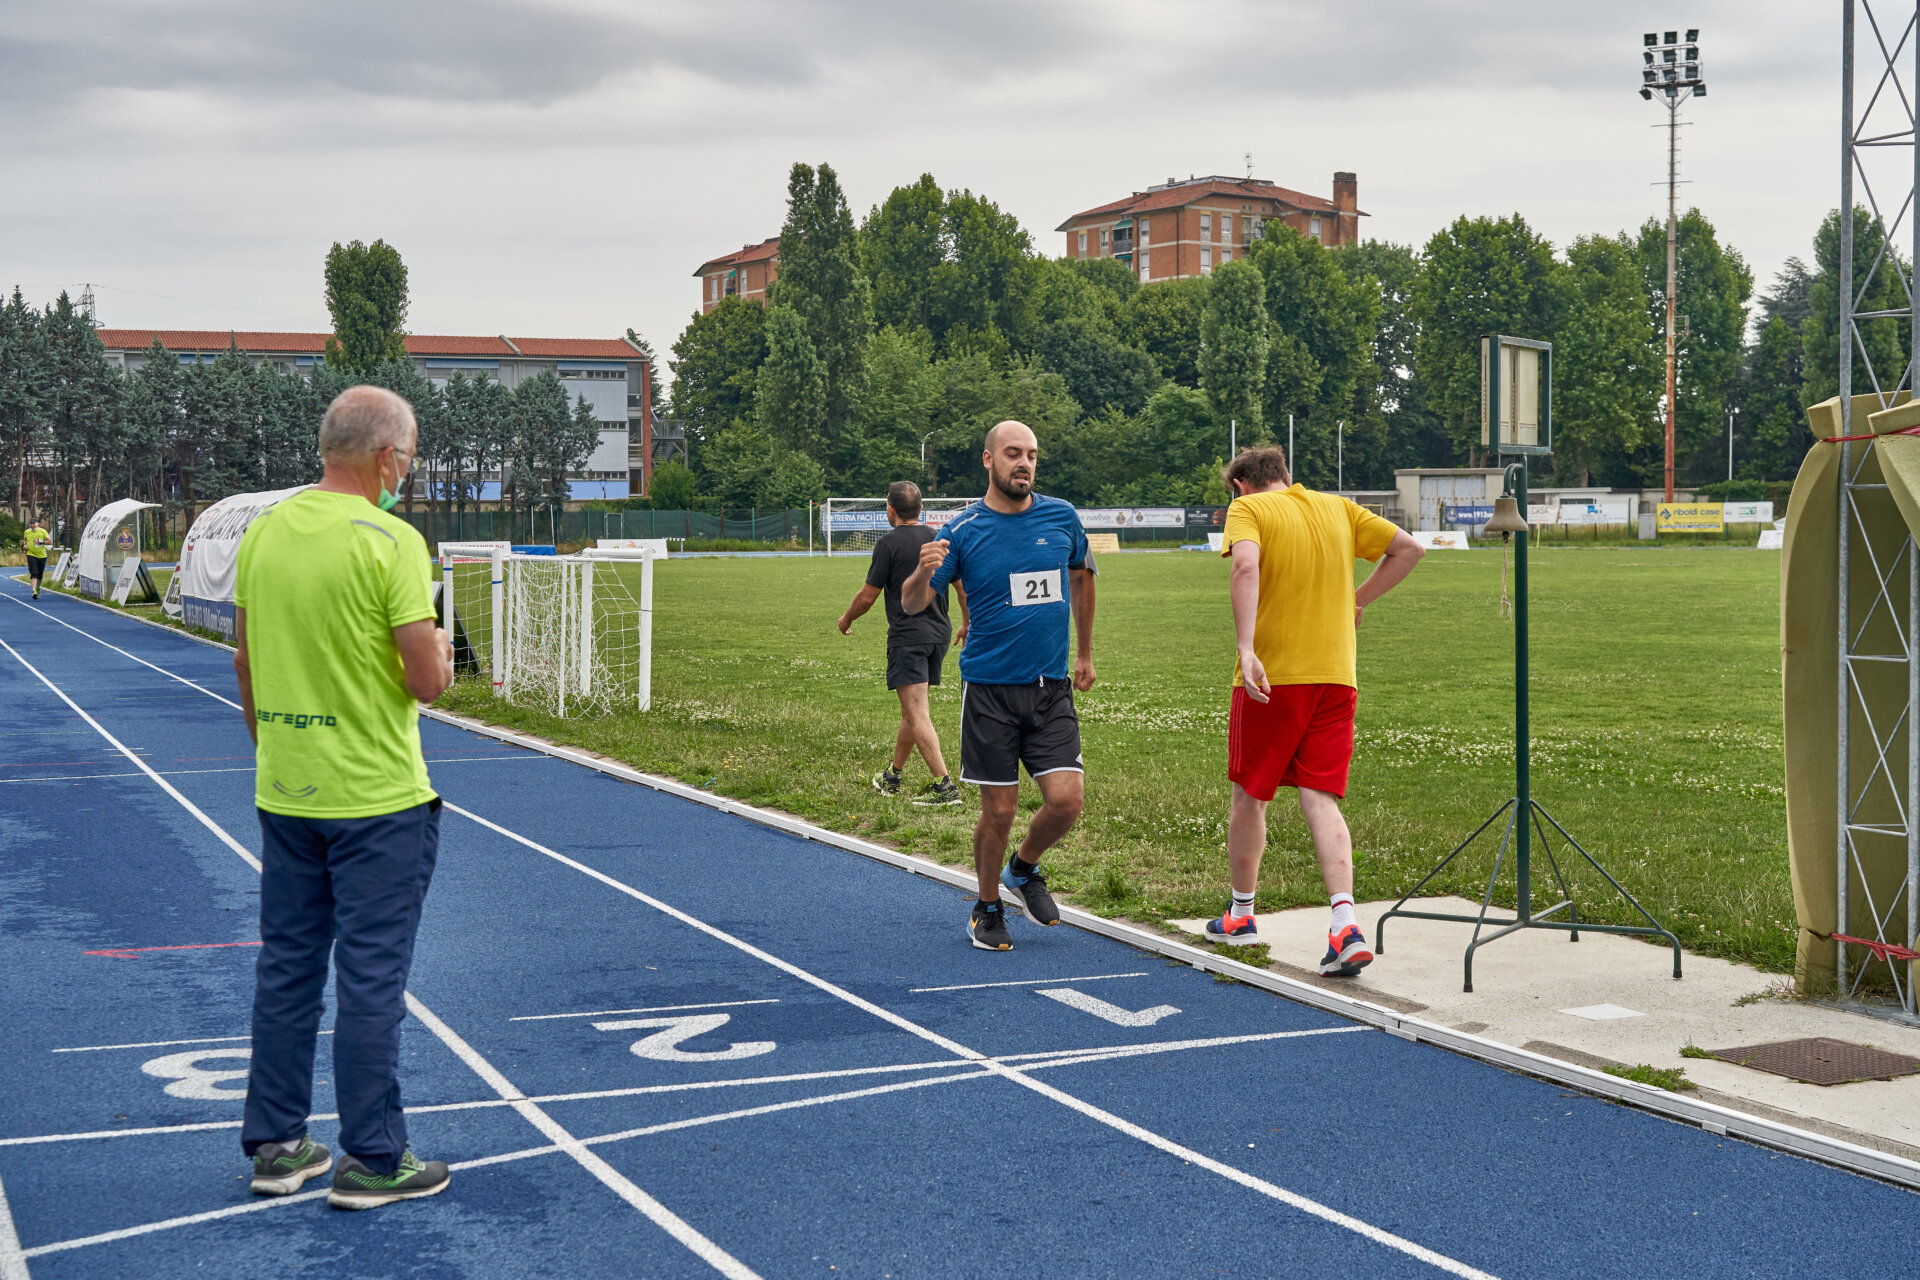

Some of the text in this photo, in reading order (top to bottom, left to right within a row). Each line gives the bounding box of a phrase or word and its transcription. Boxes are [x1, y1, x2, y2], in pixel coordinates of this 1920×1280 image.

[857, 514, 873, 522] PACI
[1026, 578, 1051, 600] 21
[590, 1013, 776, 1062] 2
